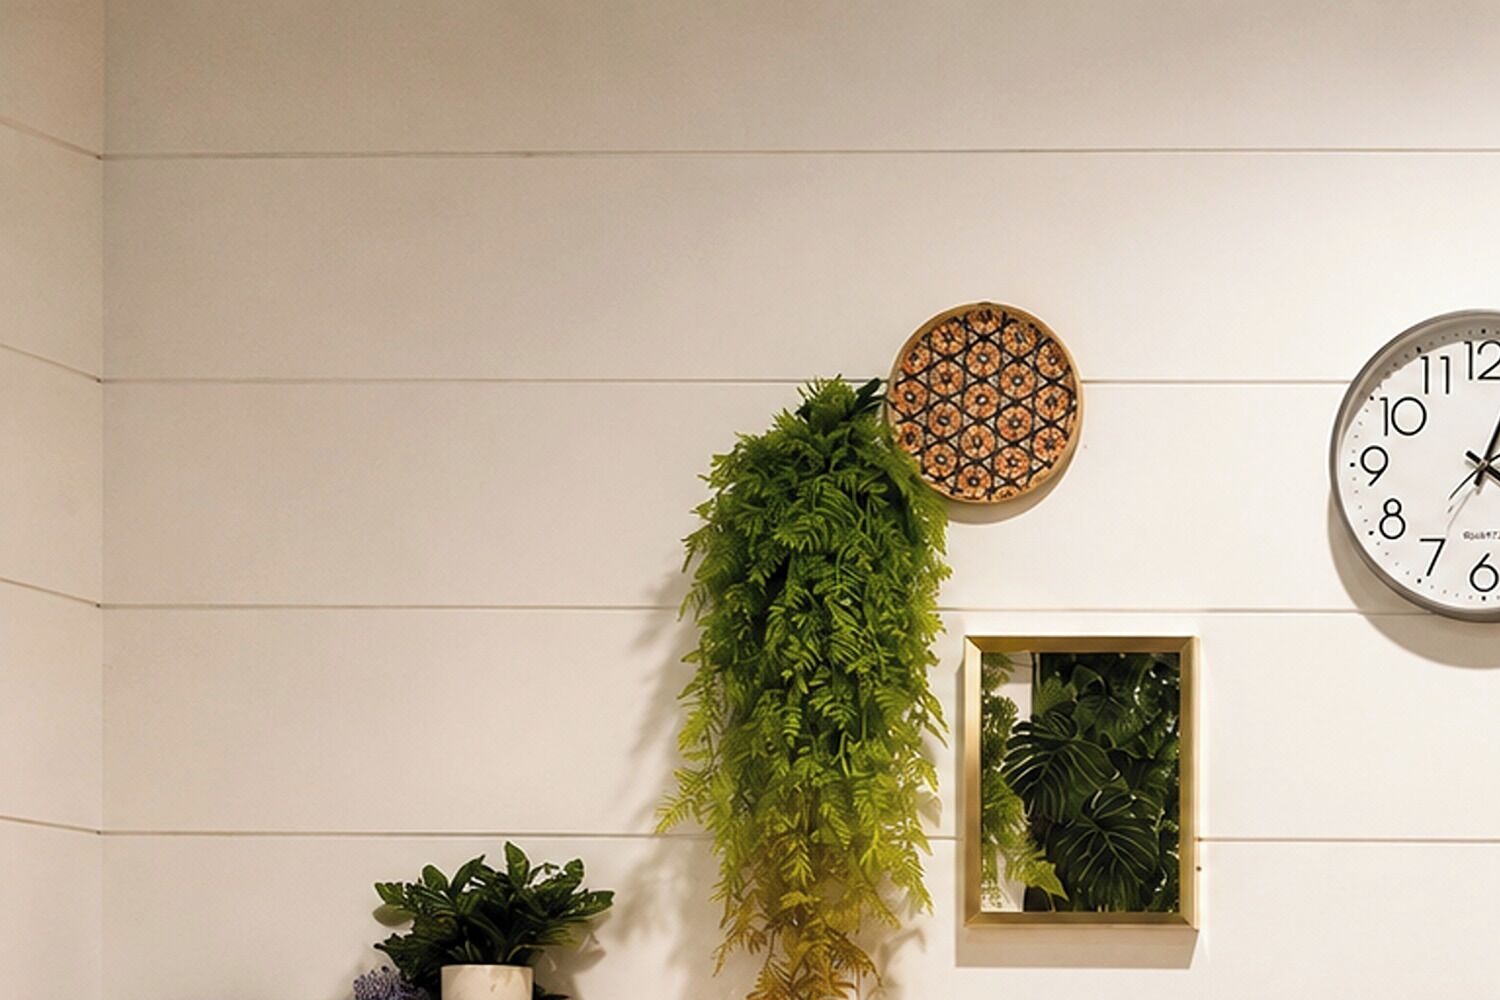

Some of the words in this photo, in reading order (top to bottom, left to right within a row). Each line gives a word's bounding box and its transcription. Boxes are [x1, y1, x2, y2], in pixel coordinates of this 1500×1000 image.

[1419, 355, 1450, 395] 11
[1379, 396, 1428, 437] 10
[1360, 445, 1389, 487] 9
[1378, 497, 1406, 540] 8
[1419, 538, 1446, 577] 7
[1469, 552, 1500, 593] 6
